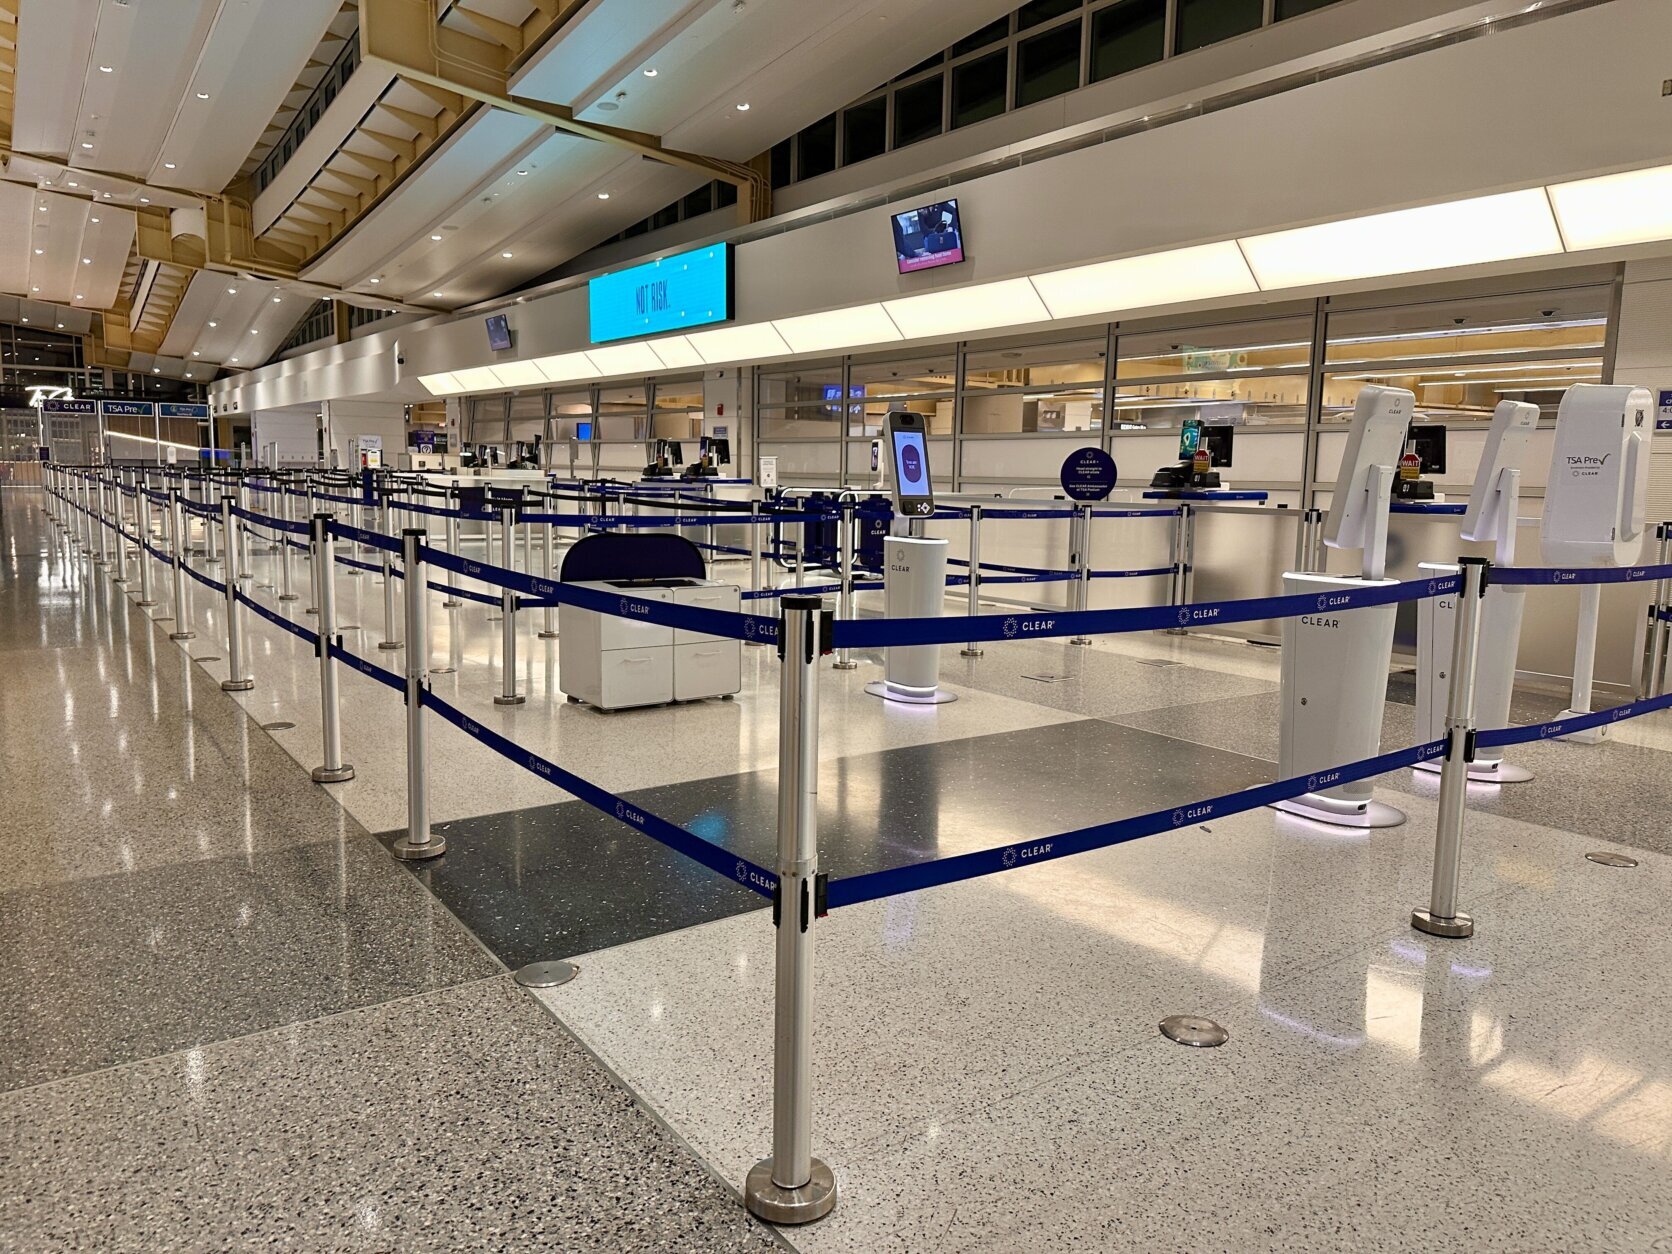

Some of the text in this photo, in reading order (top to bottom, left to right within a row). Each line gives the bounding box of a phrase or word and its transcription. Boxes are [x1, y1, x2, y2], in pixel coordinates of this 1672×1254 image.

[636, 284, 649, 315] NOT
[108, 404, 123, 413] TSA
[1566, 456, 1582, 464] TSA
[469, 565, 481, 574] CLEAR
[891, 565, 910, 573] CLEAR
[539, 584, 554, 594] CLEAR
[1438, 581, 1456, 590] CLEAR
[1329, 596, 1350, 605] CLEAR
[630, 603, 649, 615] CLEAR
[1193, 608, 1220, 619] CLEAR
[1022, 620, 1055, 631] CLEAR
[1301, 616, 1340, 629] CLEAR
[1548, 725, 1562, 733] CLEAR
[1426, 744, 1445, 755] CLEAR
[536, 762, 551, 775] CLEAR
[1319, 772, 1340, 784] CLEAR
[626, 809, 645, 825] CLEAR
[1187, 805, 1213, 818] CLEAR
[1021, 843, 1053, 858] CLEAR
[750, 872, 777, 892] CLEAR
